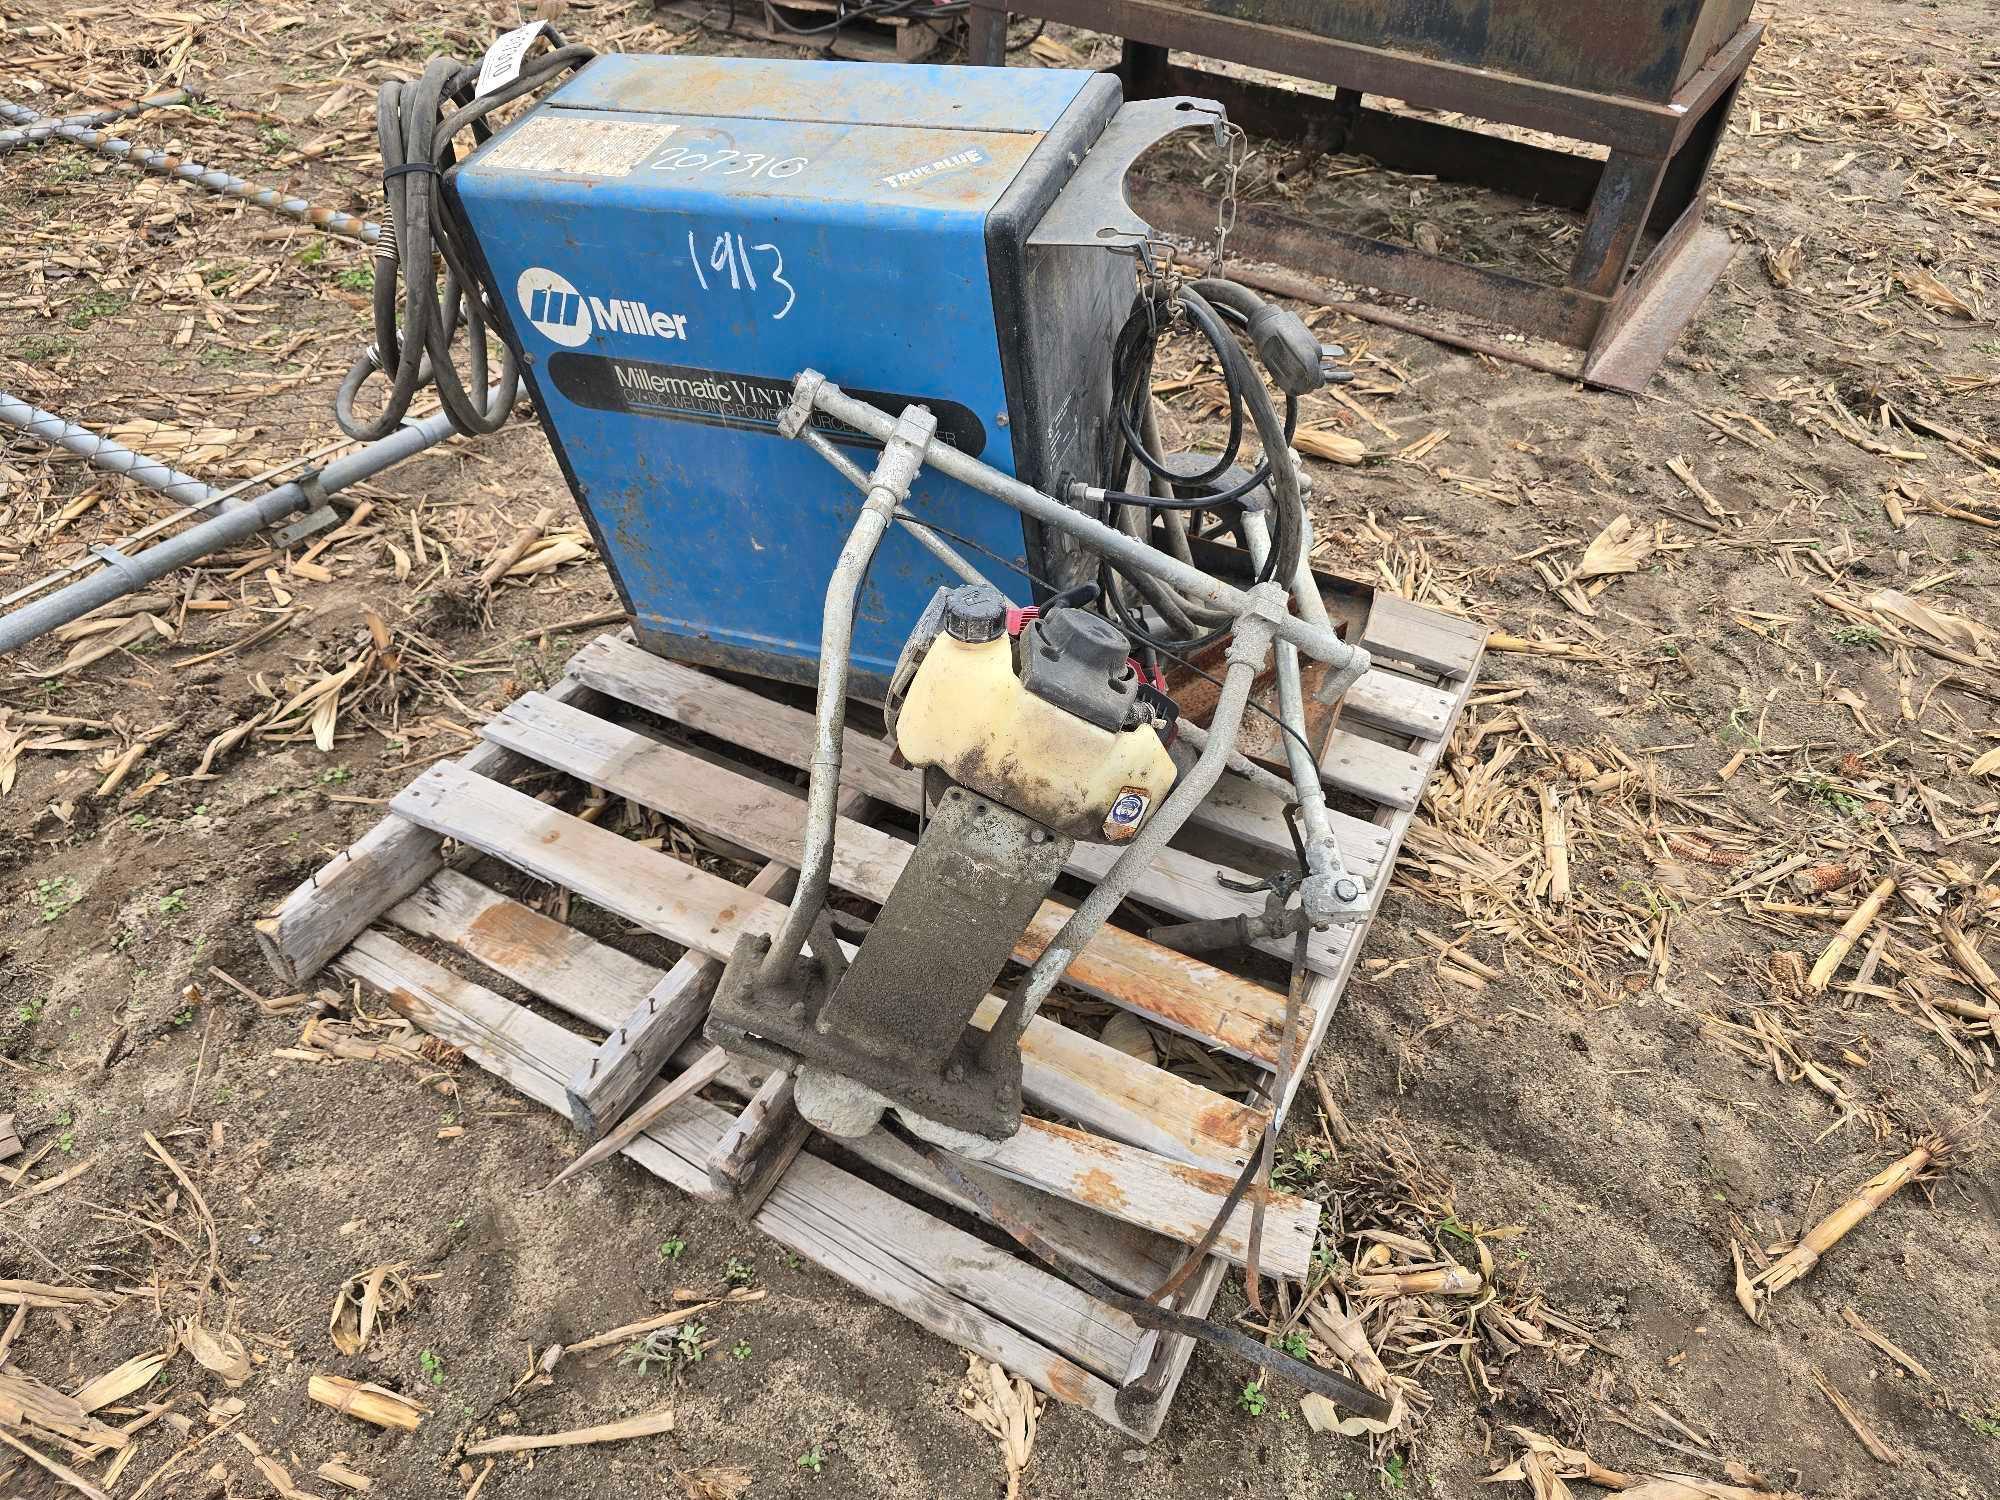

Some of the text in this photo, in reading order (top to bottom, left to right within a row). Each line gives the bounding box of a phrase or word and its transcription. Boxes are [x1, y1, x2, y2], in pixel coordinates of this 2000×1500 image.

[881, 149, 984, 188] TRUE BLUE
[688, 230, 796, 320] 1913
[589, 296, 688, 341] Miller
[614, 365, 732, 402] Millermatic
[671, 395, 734, 416] WELDING
[736, 404, 777, 421] POWE
